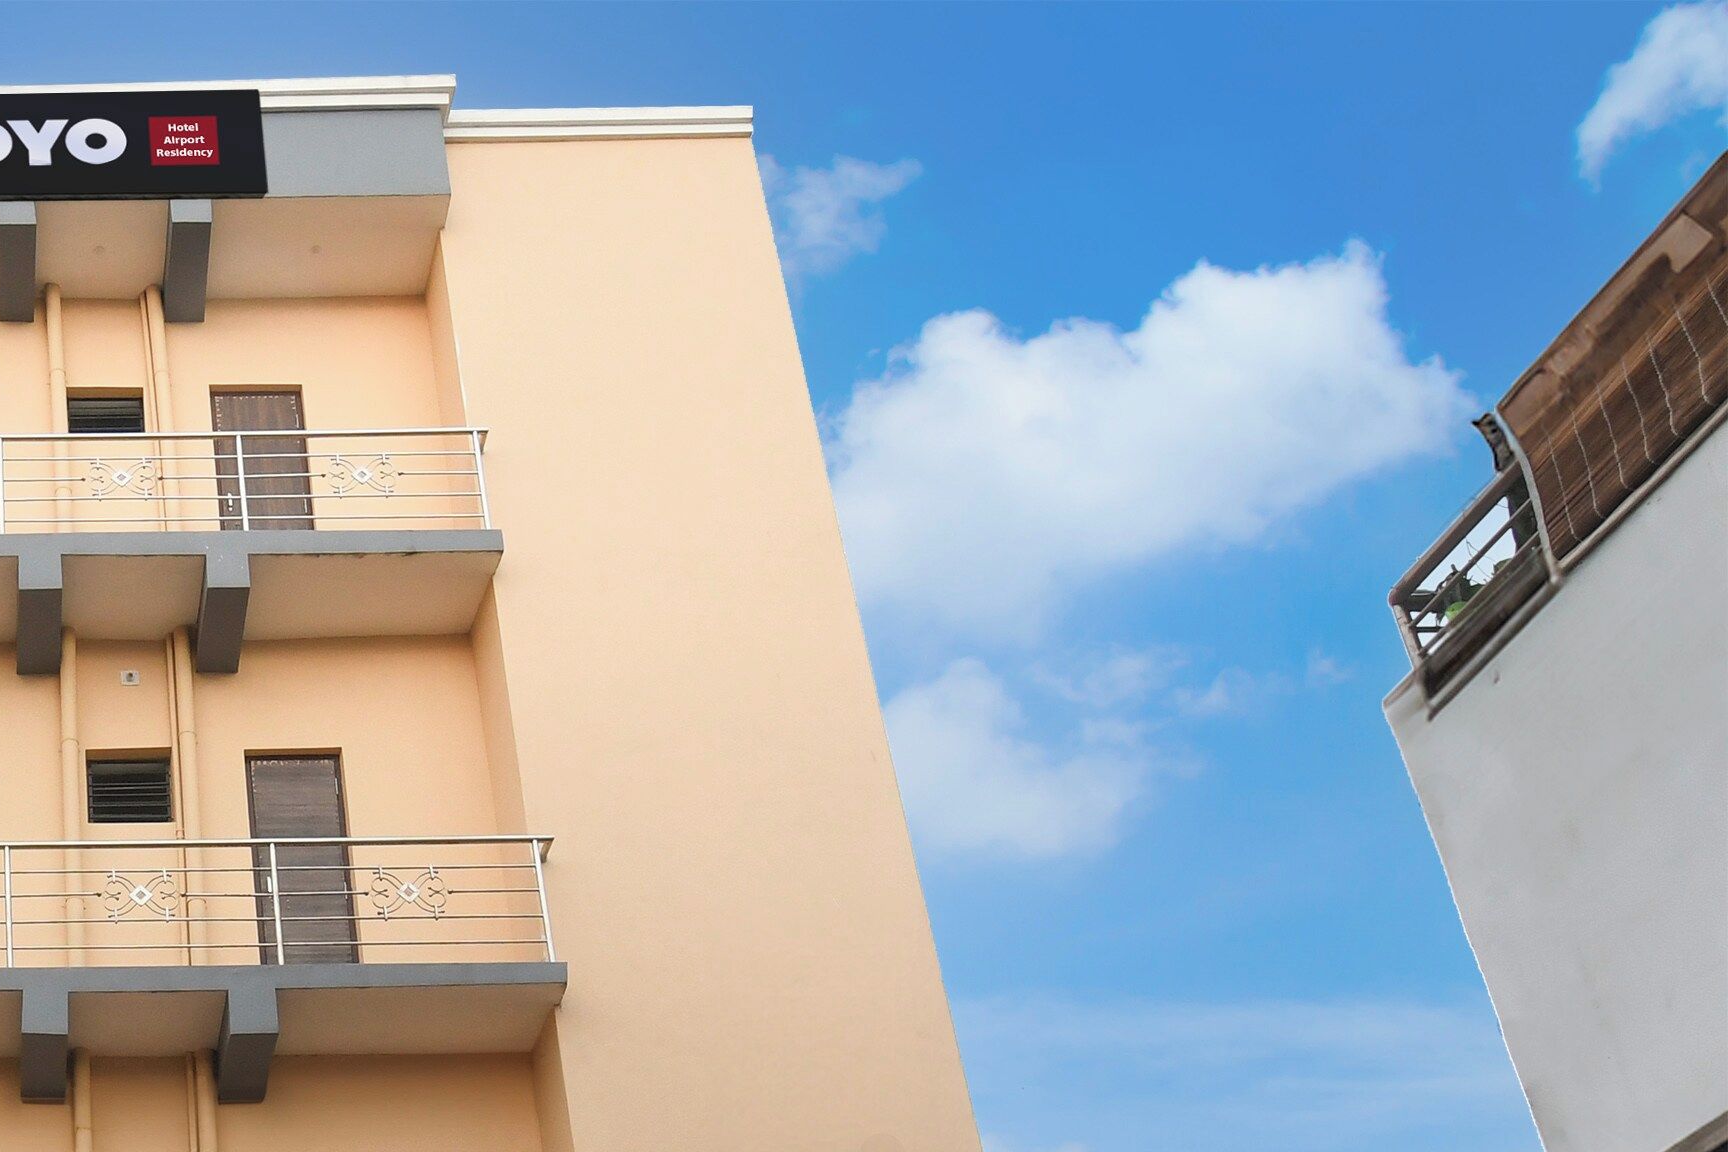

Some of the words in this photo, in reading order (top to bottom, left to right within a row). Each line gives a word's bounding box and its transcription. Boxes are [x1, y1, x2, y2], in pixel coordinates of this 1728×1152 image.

[167, 122, 199, 132] Hotel
[163, 135, 205, 146] Airport
[156, 148, 214, 158] Residency
